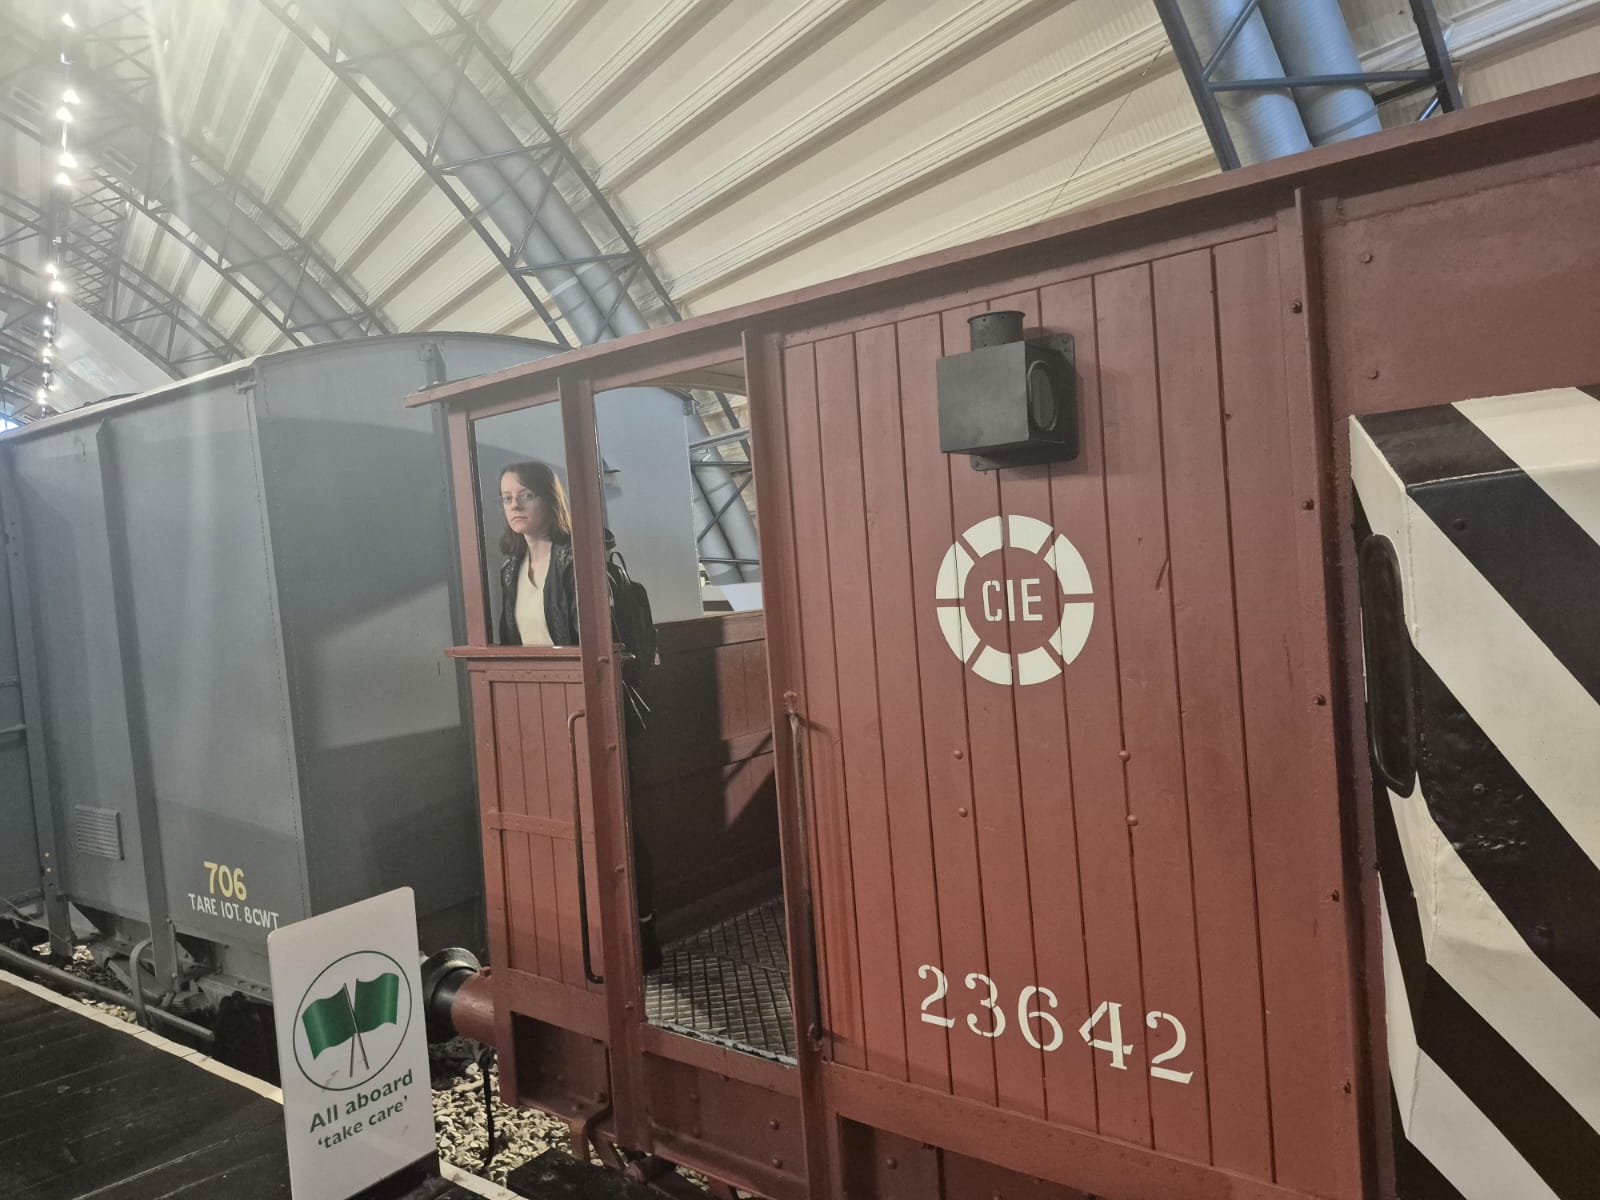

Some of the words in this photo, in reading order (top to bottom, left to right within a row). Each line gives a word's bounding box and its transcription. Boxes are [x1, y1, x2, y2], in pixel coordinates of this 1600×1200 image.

[982, 578, 1043, 622] CIE
[203, 861, 247, 901] 706
[188, 893, 218, 916] TARE
[244, 906, 279, 931] 8CWT
[918, 964, 1193, 1084] 23642
[310, 1104, 339, 1133] All
[345, 1068, 413, 1115] aboard
